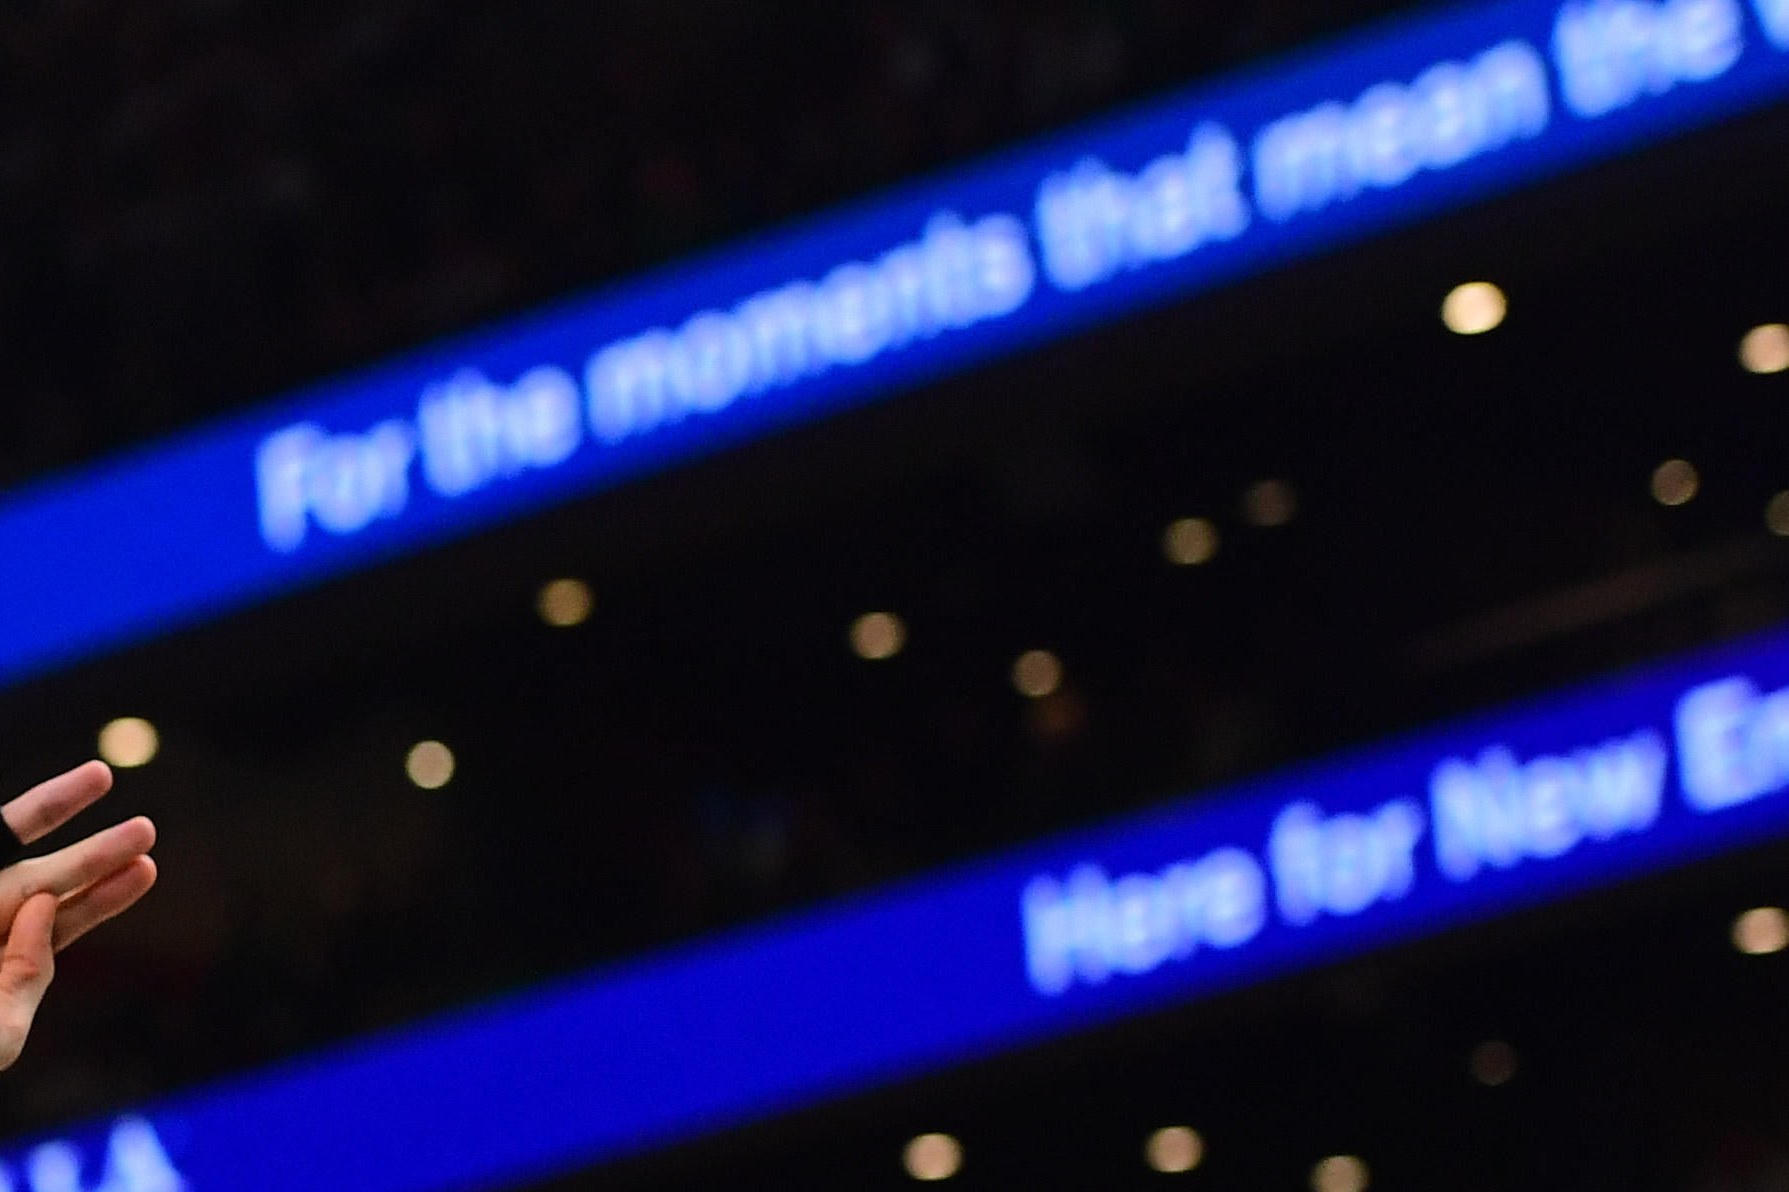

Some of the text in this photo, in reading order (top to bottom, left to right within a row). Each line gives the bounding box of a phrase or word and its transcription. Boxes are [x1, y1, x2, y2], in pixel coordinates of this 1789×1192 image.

[256, 422, 410, 551] For
[417, 366, 581, 498] the
[584, 208, 1036, 445] moments
[1036, 119, 1248, 292] that
[1251, 37, 1550, 222] mean
[1021, 847, 1266, 995] Here
[1269, 798, 1424, 926] for
[1428, 727, 1667, 882] New
